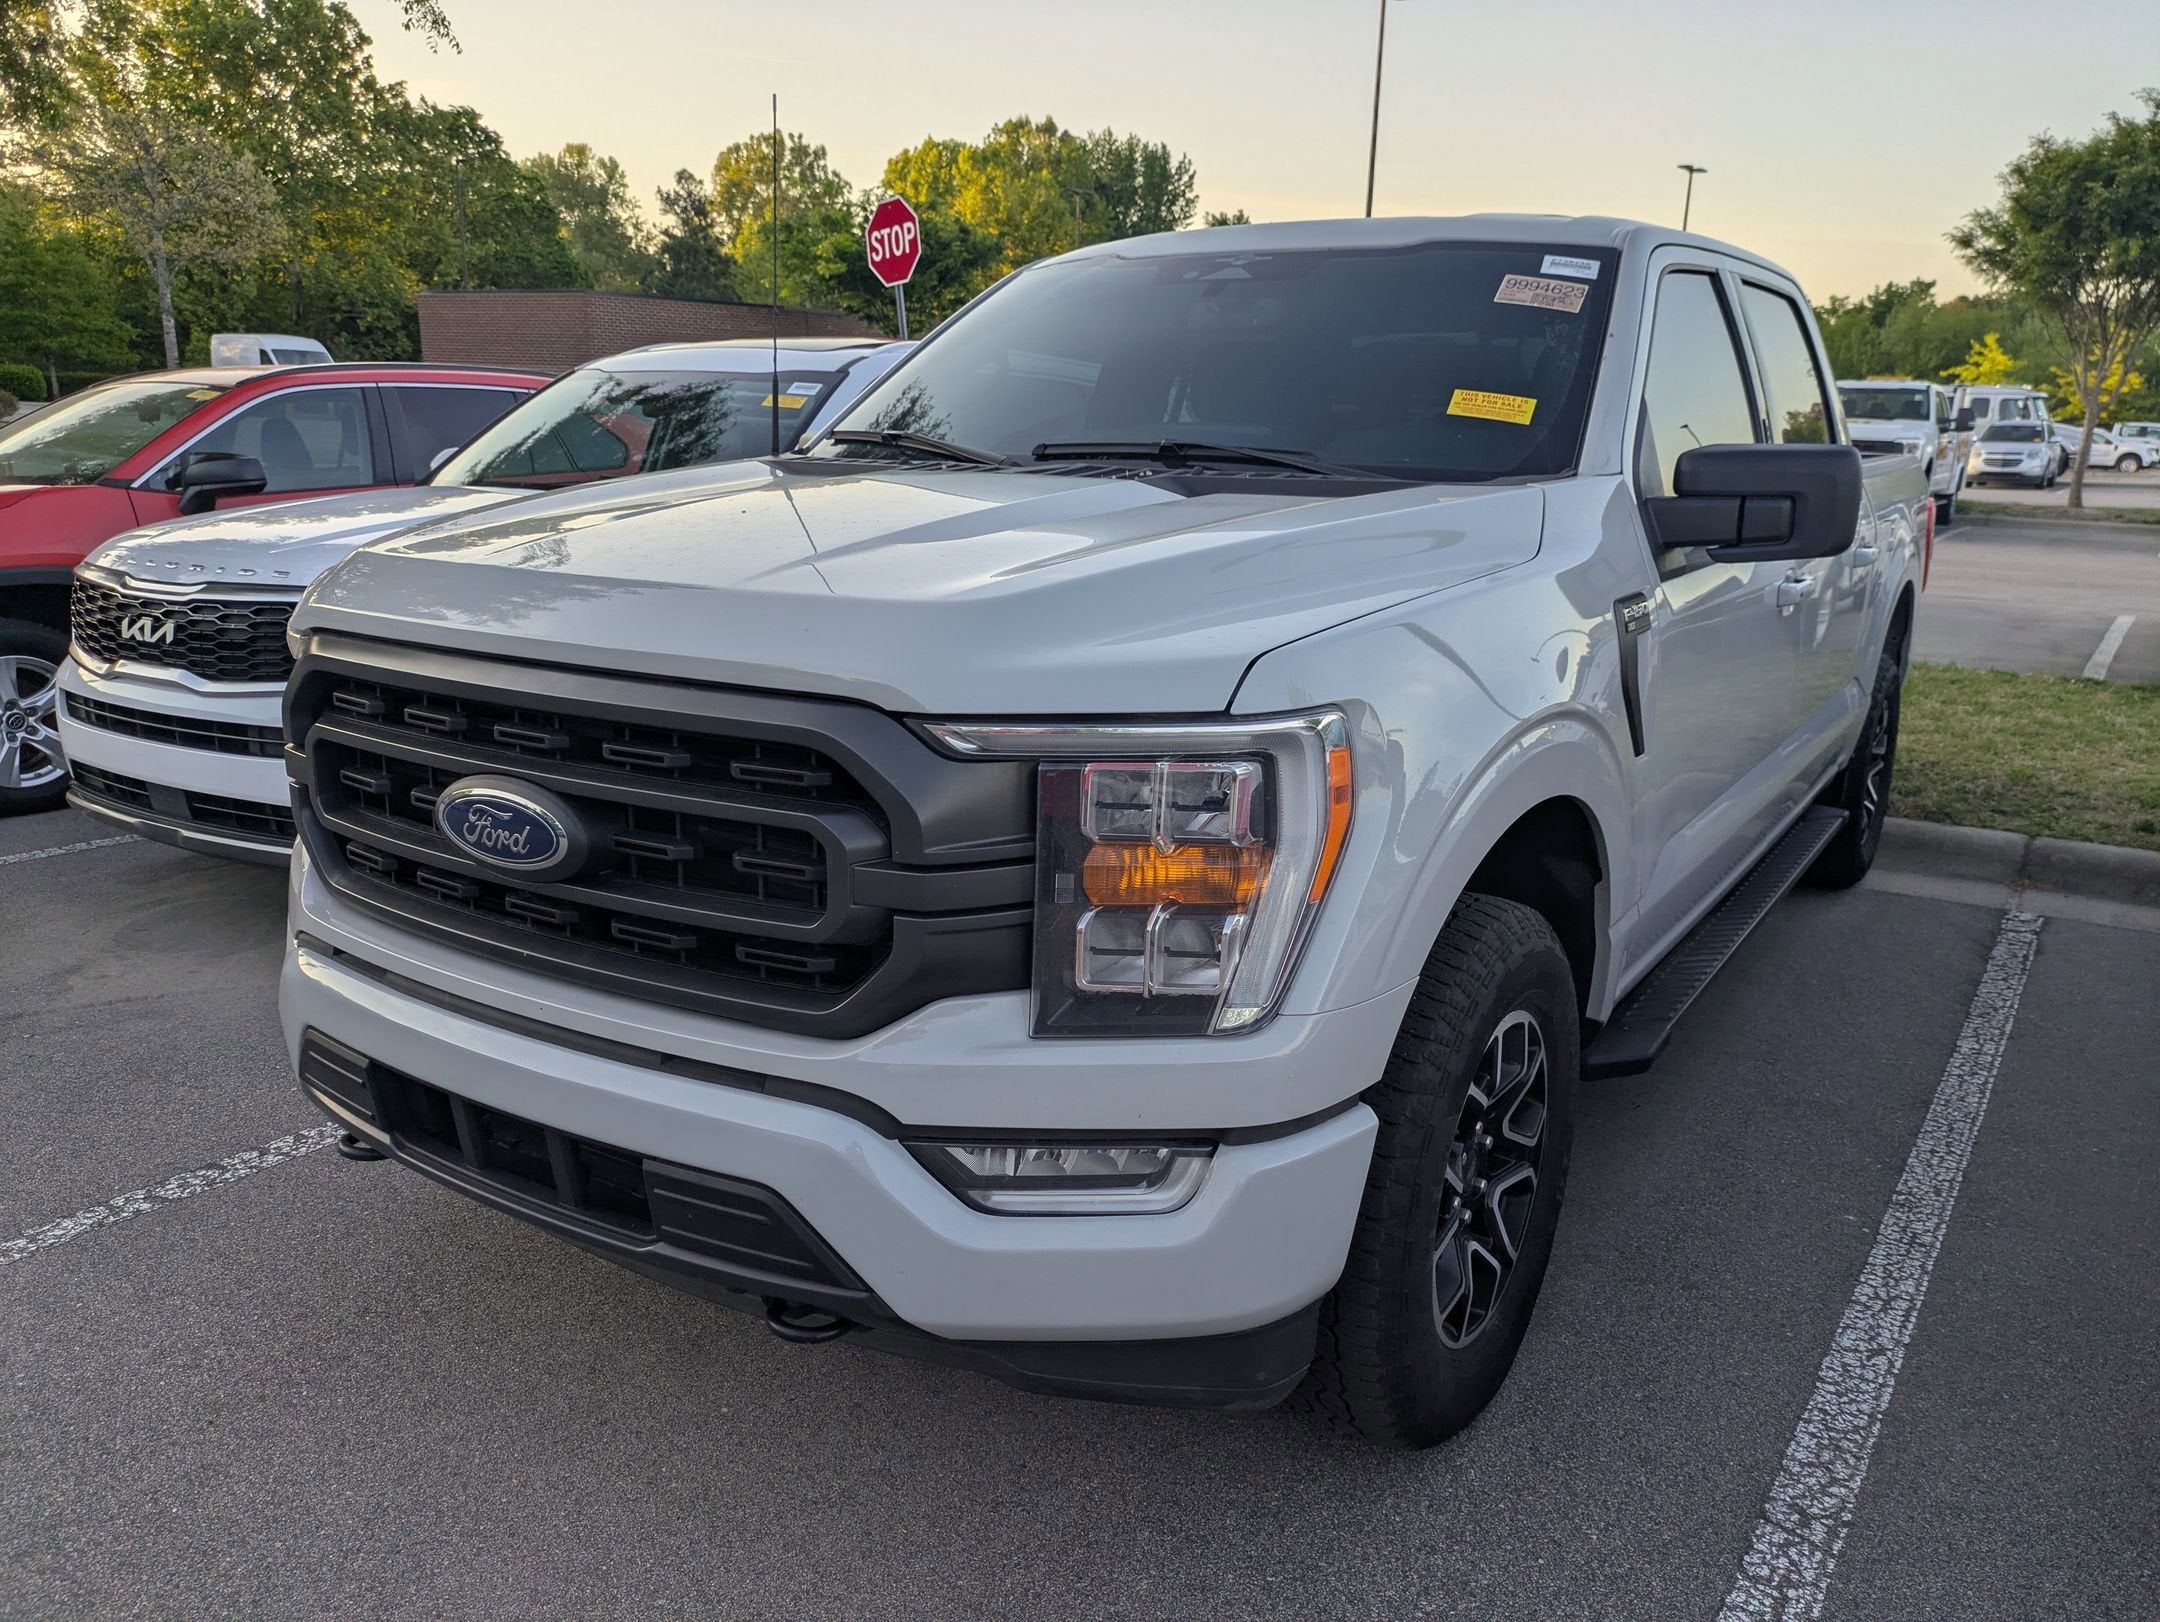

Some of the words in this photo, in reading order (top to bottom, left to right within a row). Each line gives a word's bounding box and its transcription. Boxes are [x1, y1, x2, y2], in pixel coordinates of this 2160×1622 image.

[871, 221, 915, 262] STOP
[1505, 278, 1585, 299] 9994623
[1482, 393, 1517, 403] VEHICLE
[1500, 401, 1523, 409] SALE
[102, 553, 291, 578] TELLURIDE
[121, 614, 176, 645] KIA
[462, 804, 530, 854] Ford
